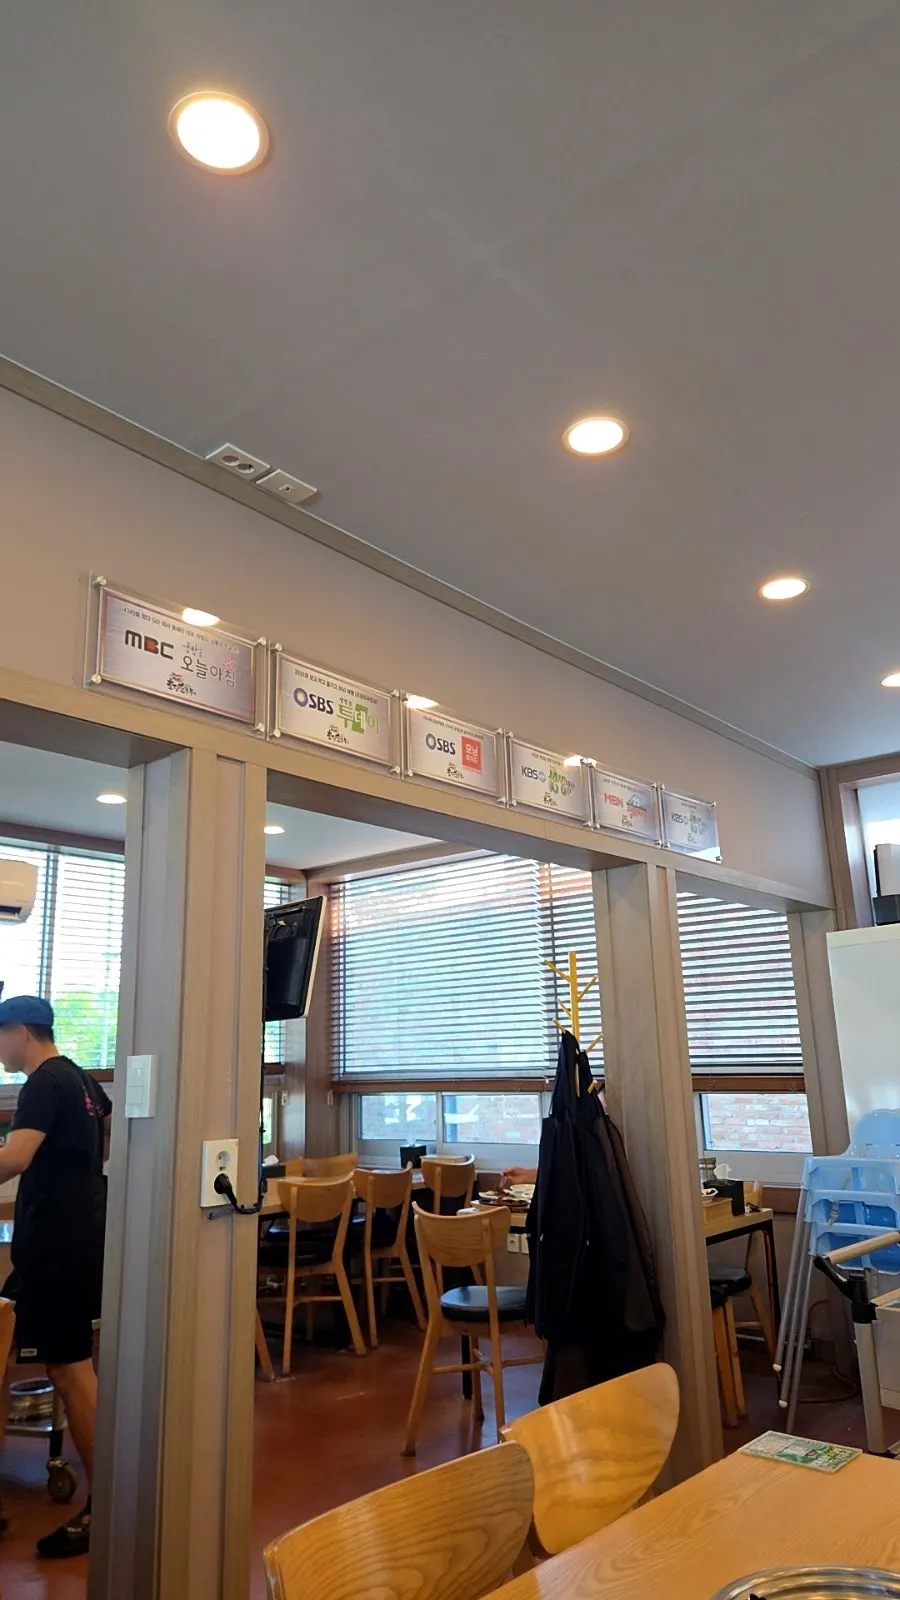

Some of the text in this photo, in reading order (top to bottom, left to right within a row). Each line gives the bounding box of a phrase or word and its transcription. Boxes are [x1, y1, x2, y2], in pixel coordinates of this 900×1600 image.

[124, 629, 175, 661] MBC
[181, 655, 236, 688] 오늘아침
[308, 693, 335, 715] SBS
[336, 703, 380, 734] 투데이
[436, 738, 456, 756] SBS
[521, 765, 539, 780] KBS
